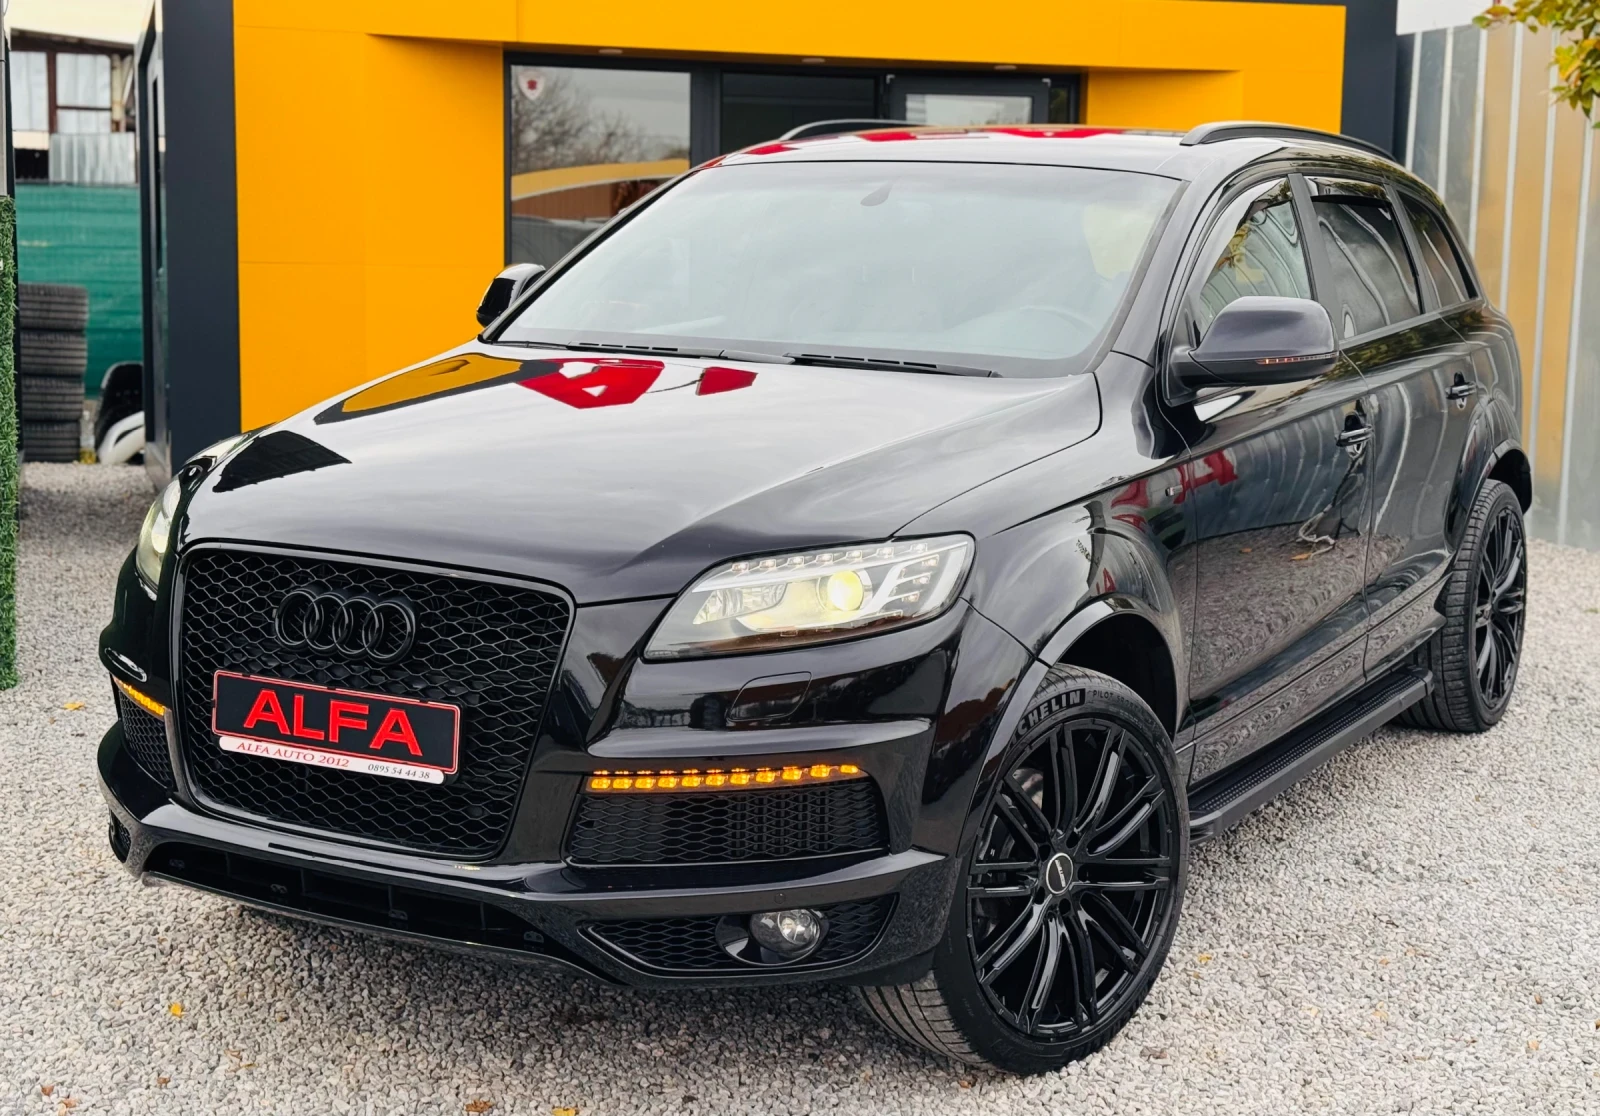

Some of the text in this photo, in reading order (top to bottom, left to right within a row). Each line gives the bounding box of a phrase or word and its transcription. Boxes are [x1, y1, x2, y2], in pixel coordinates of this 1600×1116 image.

[1092, 689, 1114, 700] PILOT
[243, 688, 423, 757] ALFA
[236, 742, 350, 768] ALFA AUTO 2012
[367, 763, 431, 780] 0895 54 44 38
